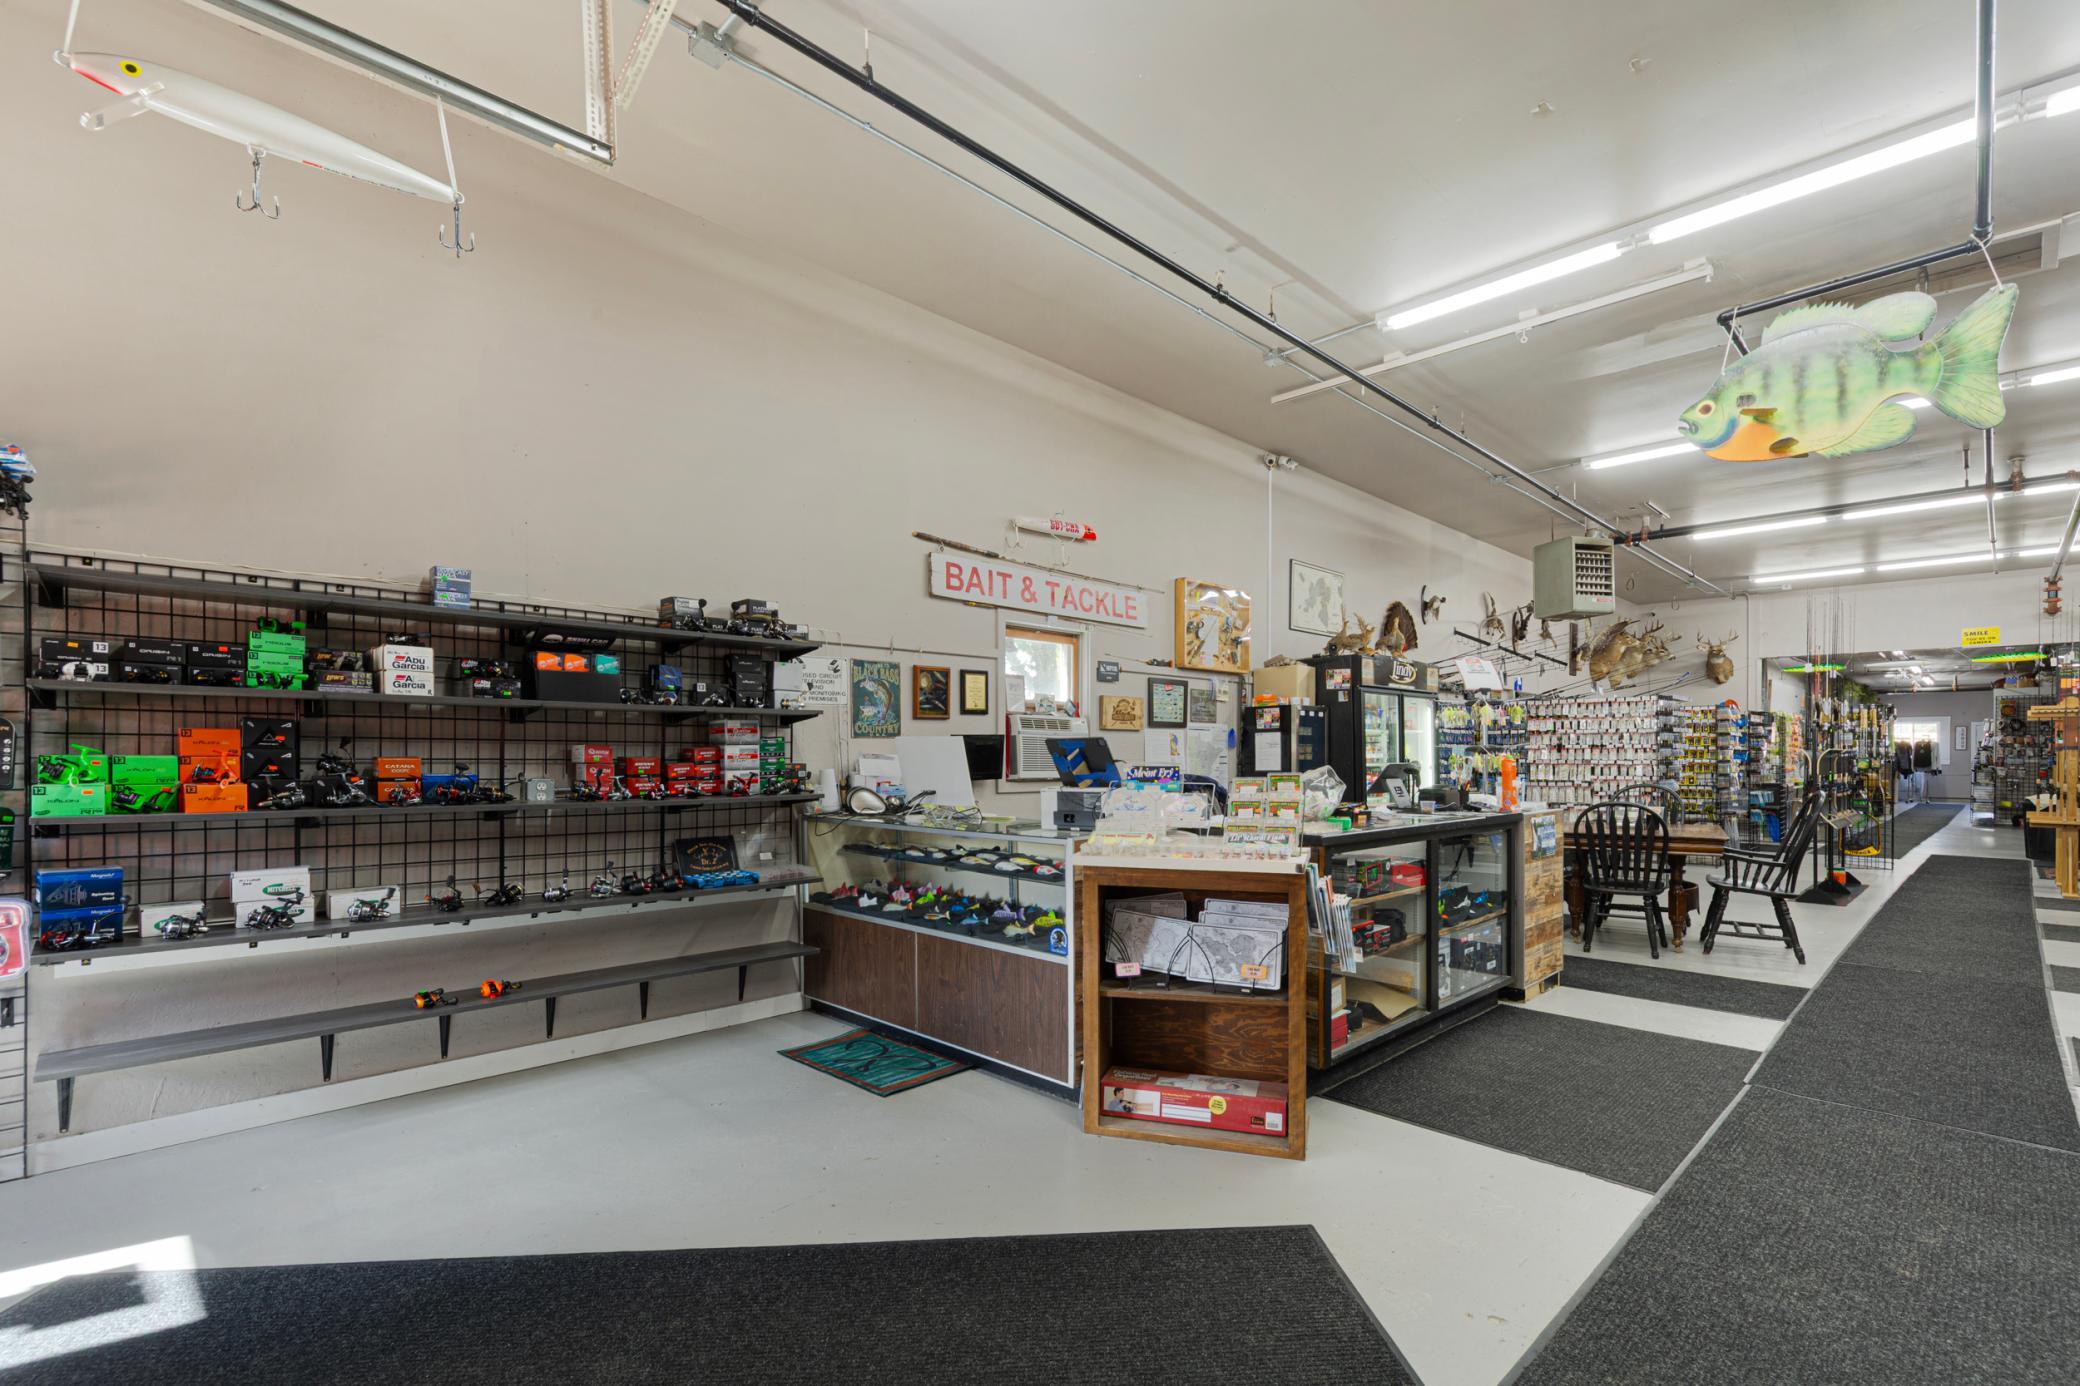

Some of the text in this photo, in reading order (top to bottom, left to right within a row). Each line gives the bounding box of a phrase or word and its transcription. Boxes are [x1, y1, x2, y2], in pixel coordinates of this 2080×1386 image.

[944, 561, 1138, 621] BAIT & TACKLE
[94, 642, 107, 651] 13
[404, 656, 426, 665] Abu
[95, 665, 107, 673] 13
[391, 661, 425, 671] Garcia
[1392, 660, 1414, 680] Lindy
[852, 665, 900, 686] BLACK BASS
[393, 680, 426, 690] Garcia
[854, 720, 899, 734] COUNTRY
[33, 787, 46, 795] 13
